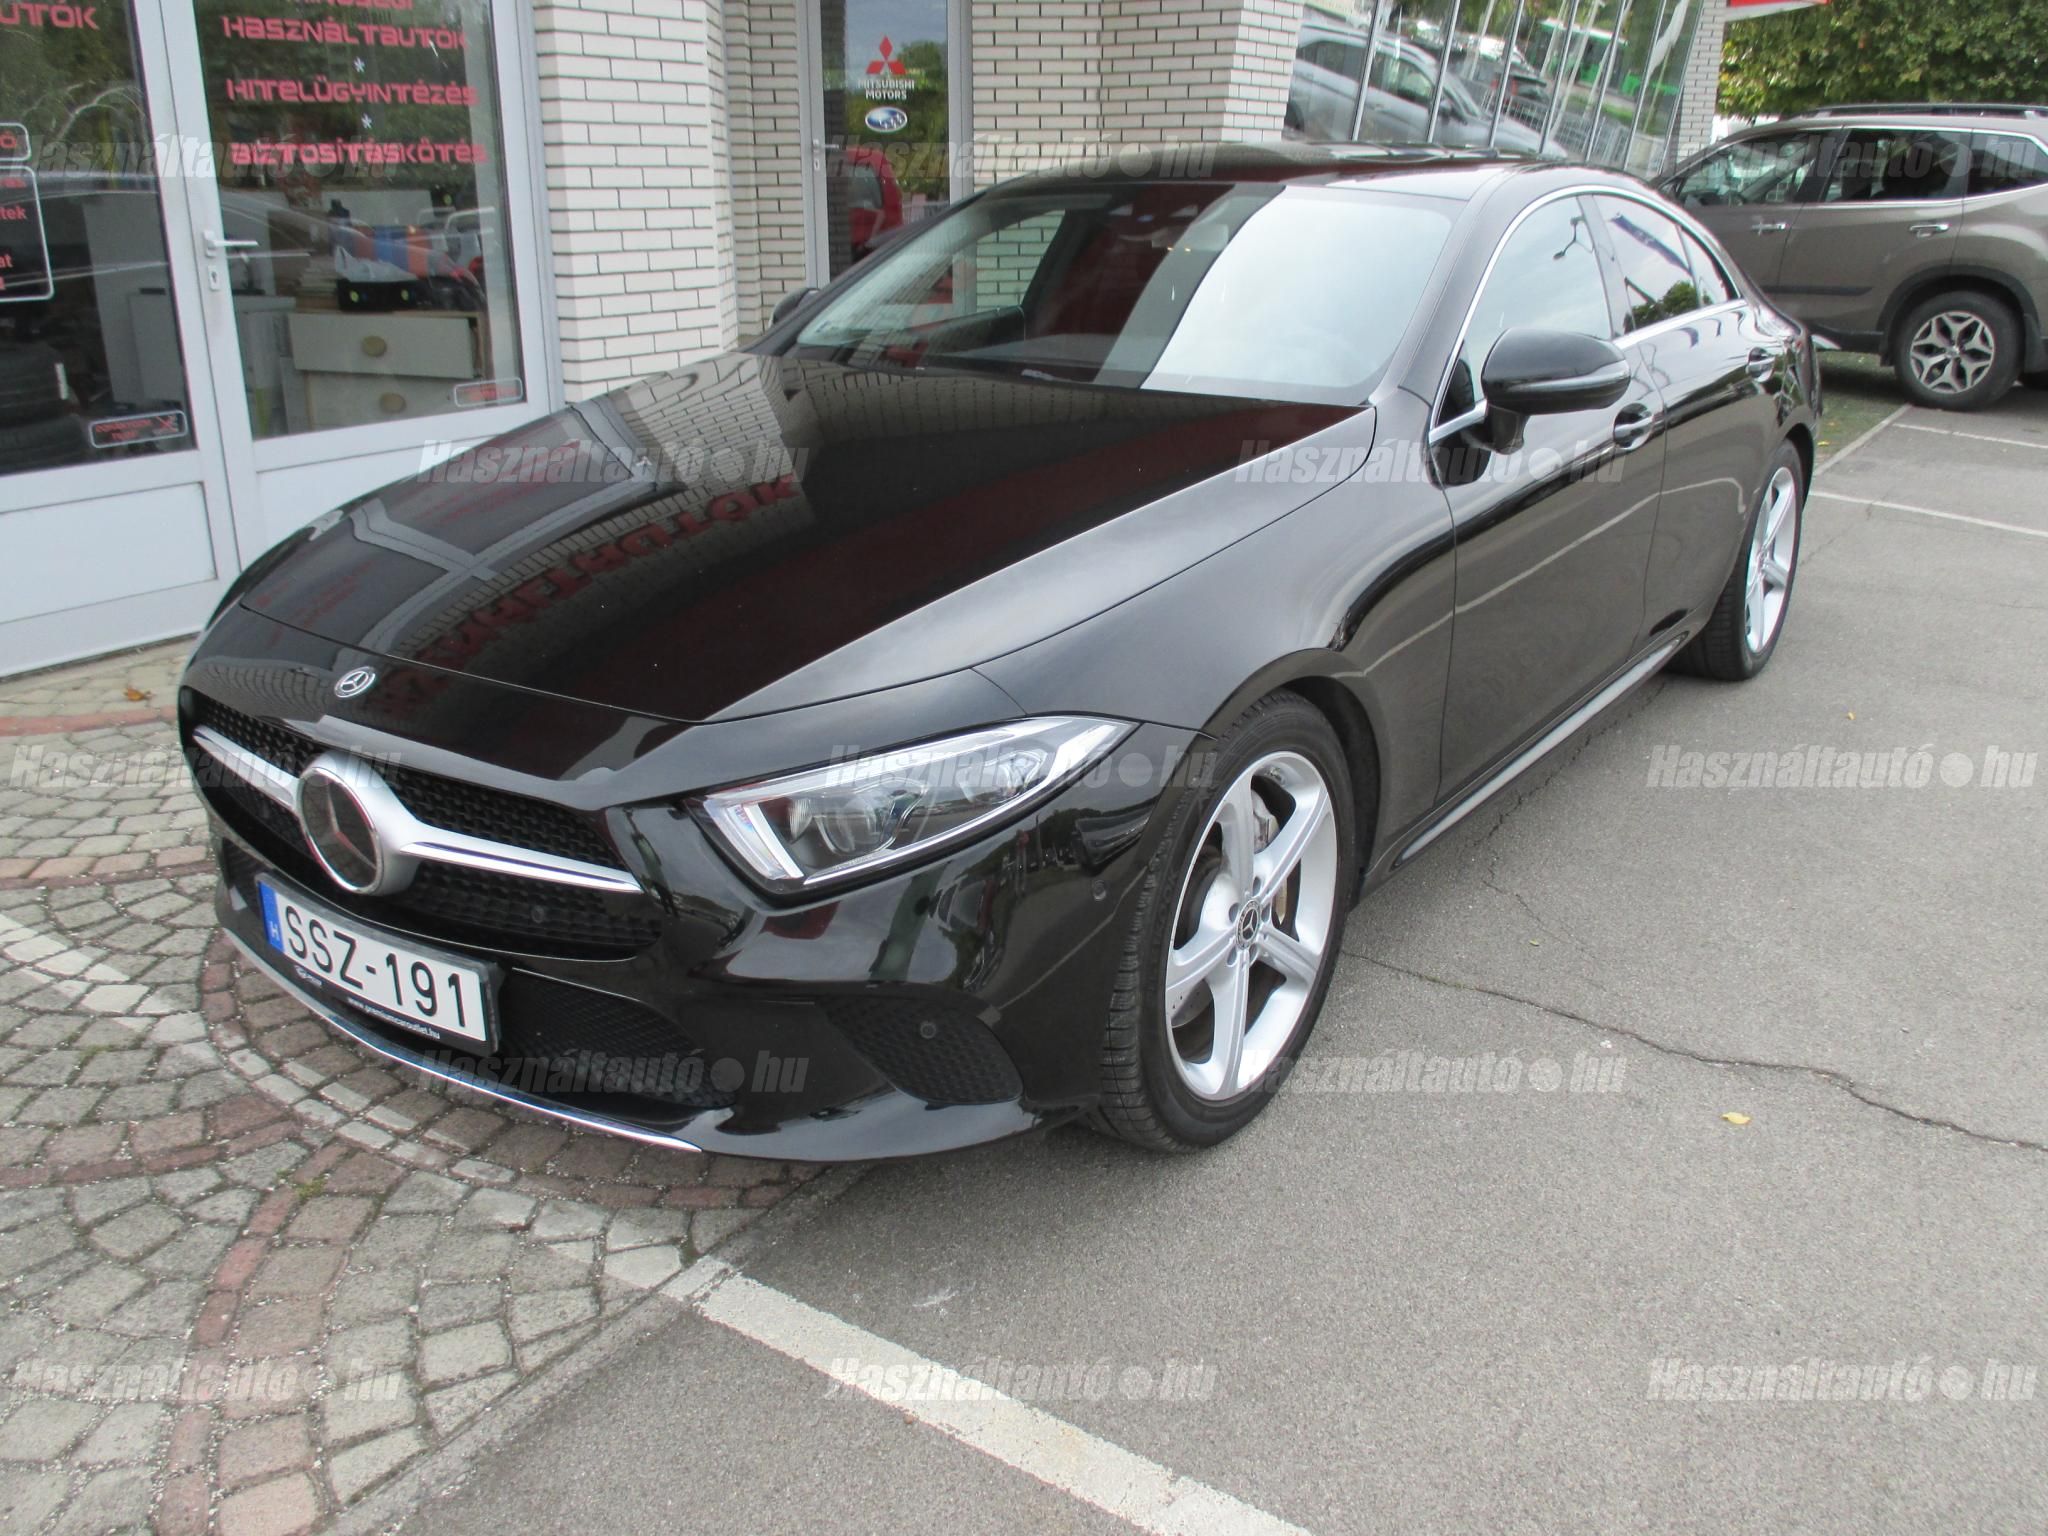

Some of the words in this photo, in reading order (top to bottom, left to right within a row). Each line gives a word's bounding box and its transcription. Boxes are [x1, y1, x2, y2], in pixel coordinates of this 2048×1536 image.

[857, 79, 915, 90] MITSUBISHI
[865, 90, 907, 100] MOTORS
[285, 905, 466, 1028] SSZ-191
